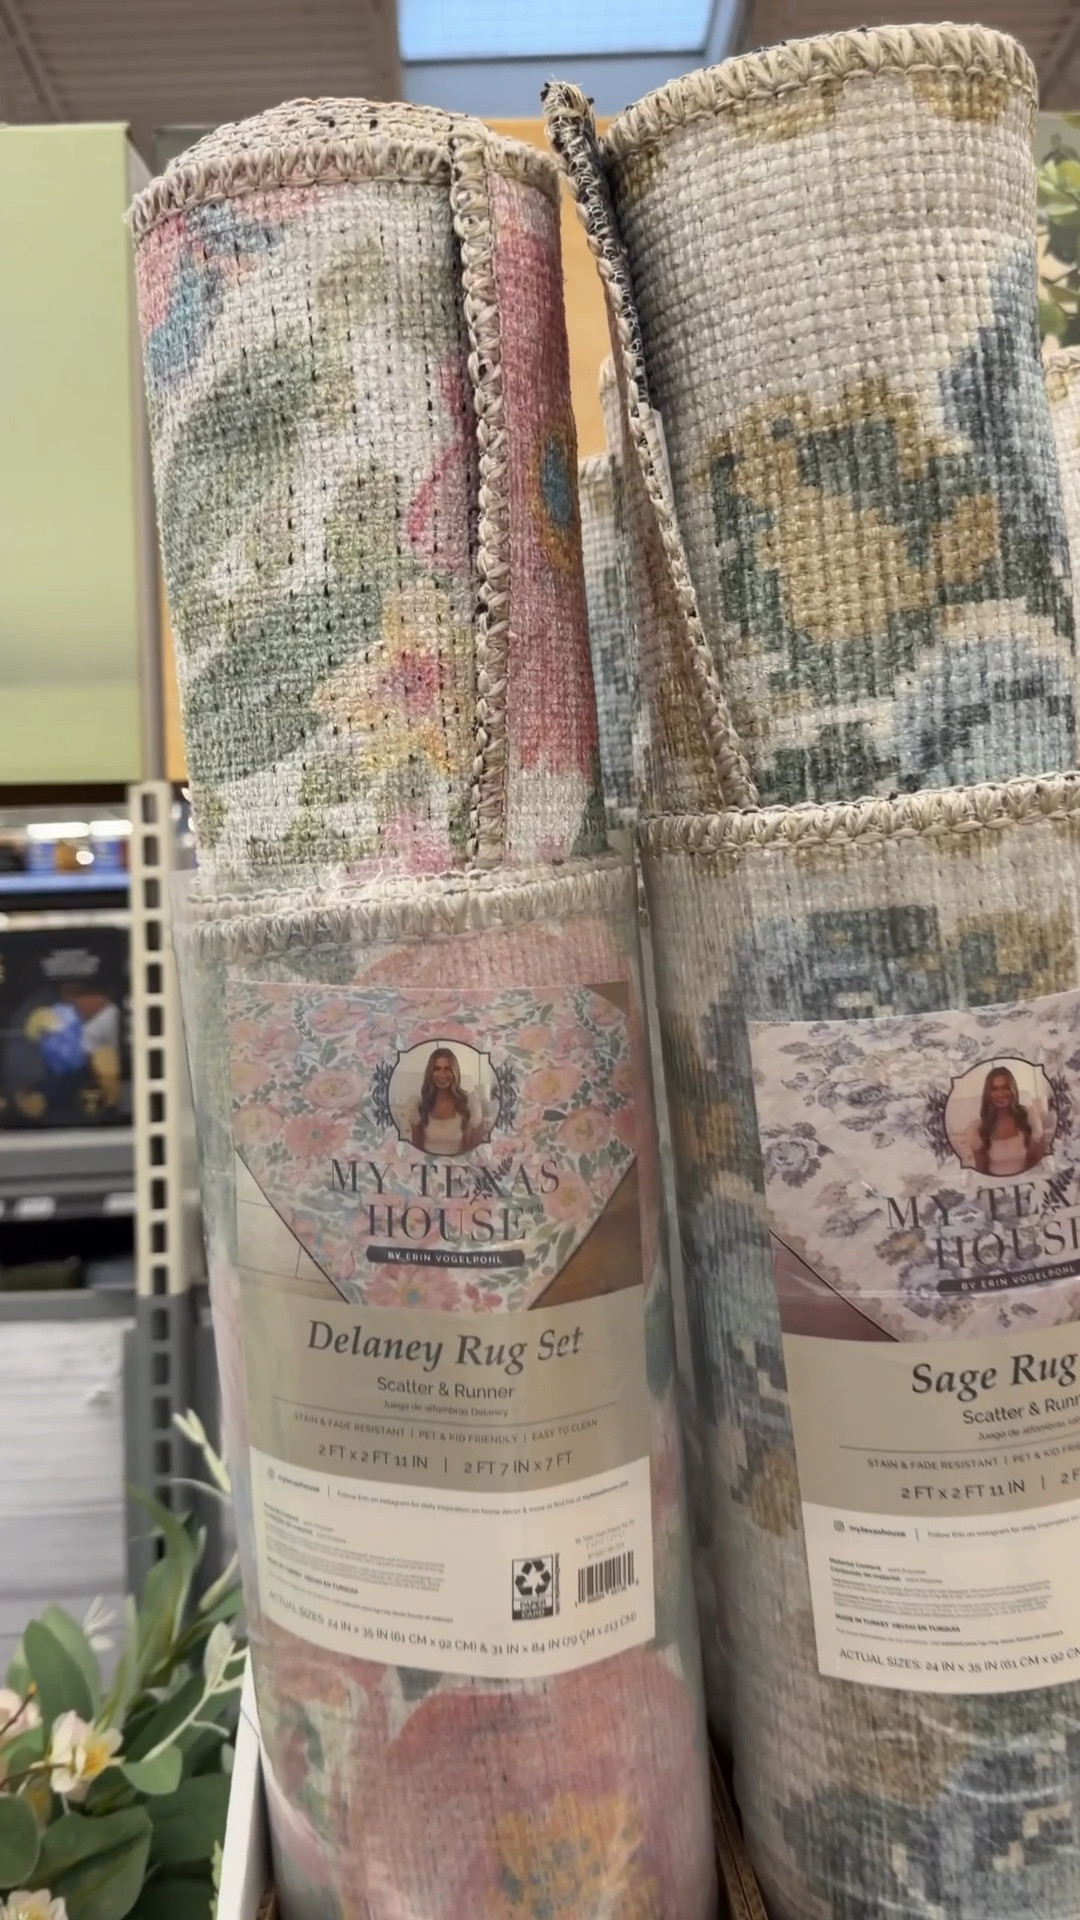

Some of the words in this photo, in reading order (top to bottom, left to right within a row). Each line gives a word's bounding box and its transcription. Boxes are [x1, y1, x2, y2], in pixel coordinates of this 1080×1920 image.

[331, 1158, 393, 1195] MY
[411, 1158, 560, 1199] TEXAS
[887, 1195, 955, 1230] MY
[976, 1177, 1080, 1221] TEX
[369, 1204, 527, 1241] HOUSE
[387, 1251, 401, 1260] BY
[406, 1252, 431, 1262] ERIN
[435, 1253, 503, 1265] VOGELPOHL
[961, 1280, 975, 1291] BY
[981, 1277, 1008, 1289] ERIN
[307, 1320, 444, 1373] Delaney
[455, 1334, 529, 1376] Rug
[537, 1325, 584, 1361] Set
[377, 1376, 434, 1396] Scatter
[438, 1381, 450, 1397] &
[454, 1383, 515, 1399] Runner
[911, 1362, 998, 1402] Sage
[1009, 1352, 1079, 1387] Rug
[962, 1406, 1024, 1425] Scatter
[1028, 1401, 1041, 1416] &
[328, 1418, 350, 1431] FADE
[354, 1422, 406, 1437] RESISTANT
[419, 1430, 436, 1440] PET
[449, 1432, 466, 1443] KID
[468, 1433, 518, 1444] FRIENDLY
[532, 1428, 555, 1442] EASY
[558, 1425, 570, 1436] TO
[571, 1418, 599, 1433] CLEAN
[318, 1444, 326, 1457] 2
[329, 1445, 346, 1459] FT
[349, 1450, 358, 1461] x
[361, 1450, 369, 1463] 2
[372, 1451, 390, 1465] FT
[395, 1455, 407, 1468] 11
[412, 1454, 428, 1470] IN
[464, 1461, 473, 1475] 2
[477, 1460, 496, 1475] FT
[501, 1462, 509, 1477] 7
[513, 1459, 530, 1474] IN
[545, 1457, 553, 1471] 7
[556, 1450, 573, 1467] FT
[867, 1458, 898, 1469] STAIN
[911, 1461, 937, 1470] FADE
[941, 1457, 999, 1470] RESISTANT
[1012, 1452, 1031, 1463] PET
[901, 1487, 911, 1500] 2
[914, 1485, 934, 1500] FT
[938, 1488, 947, 1500] x
[951, 1486, 961, 1499] 2
[964, 1484, 985, 1499] FT
[990, 1483, 1004, 1496] 11
[1008, 1478, 1026, 1494] IN
[1061, 1472, 1070, 1484] 2
[341, 1620, 351, 1633] IN
[363, 1627, 374, 1639] 35
[376, 1628, 388, 1640] IN
[408, 1631, 427, 1646] CM
[506, 1643, 519, 1655] IN
[549, 1639, 560, 1651] IN
[839, 1647, 885, 1666] ACTUAL
[941, 1660, 955, 1672] IN
[983, 1659, 998, 1671] IN
